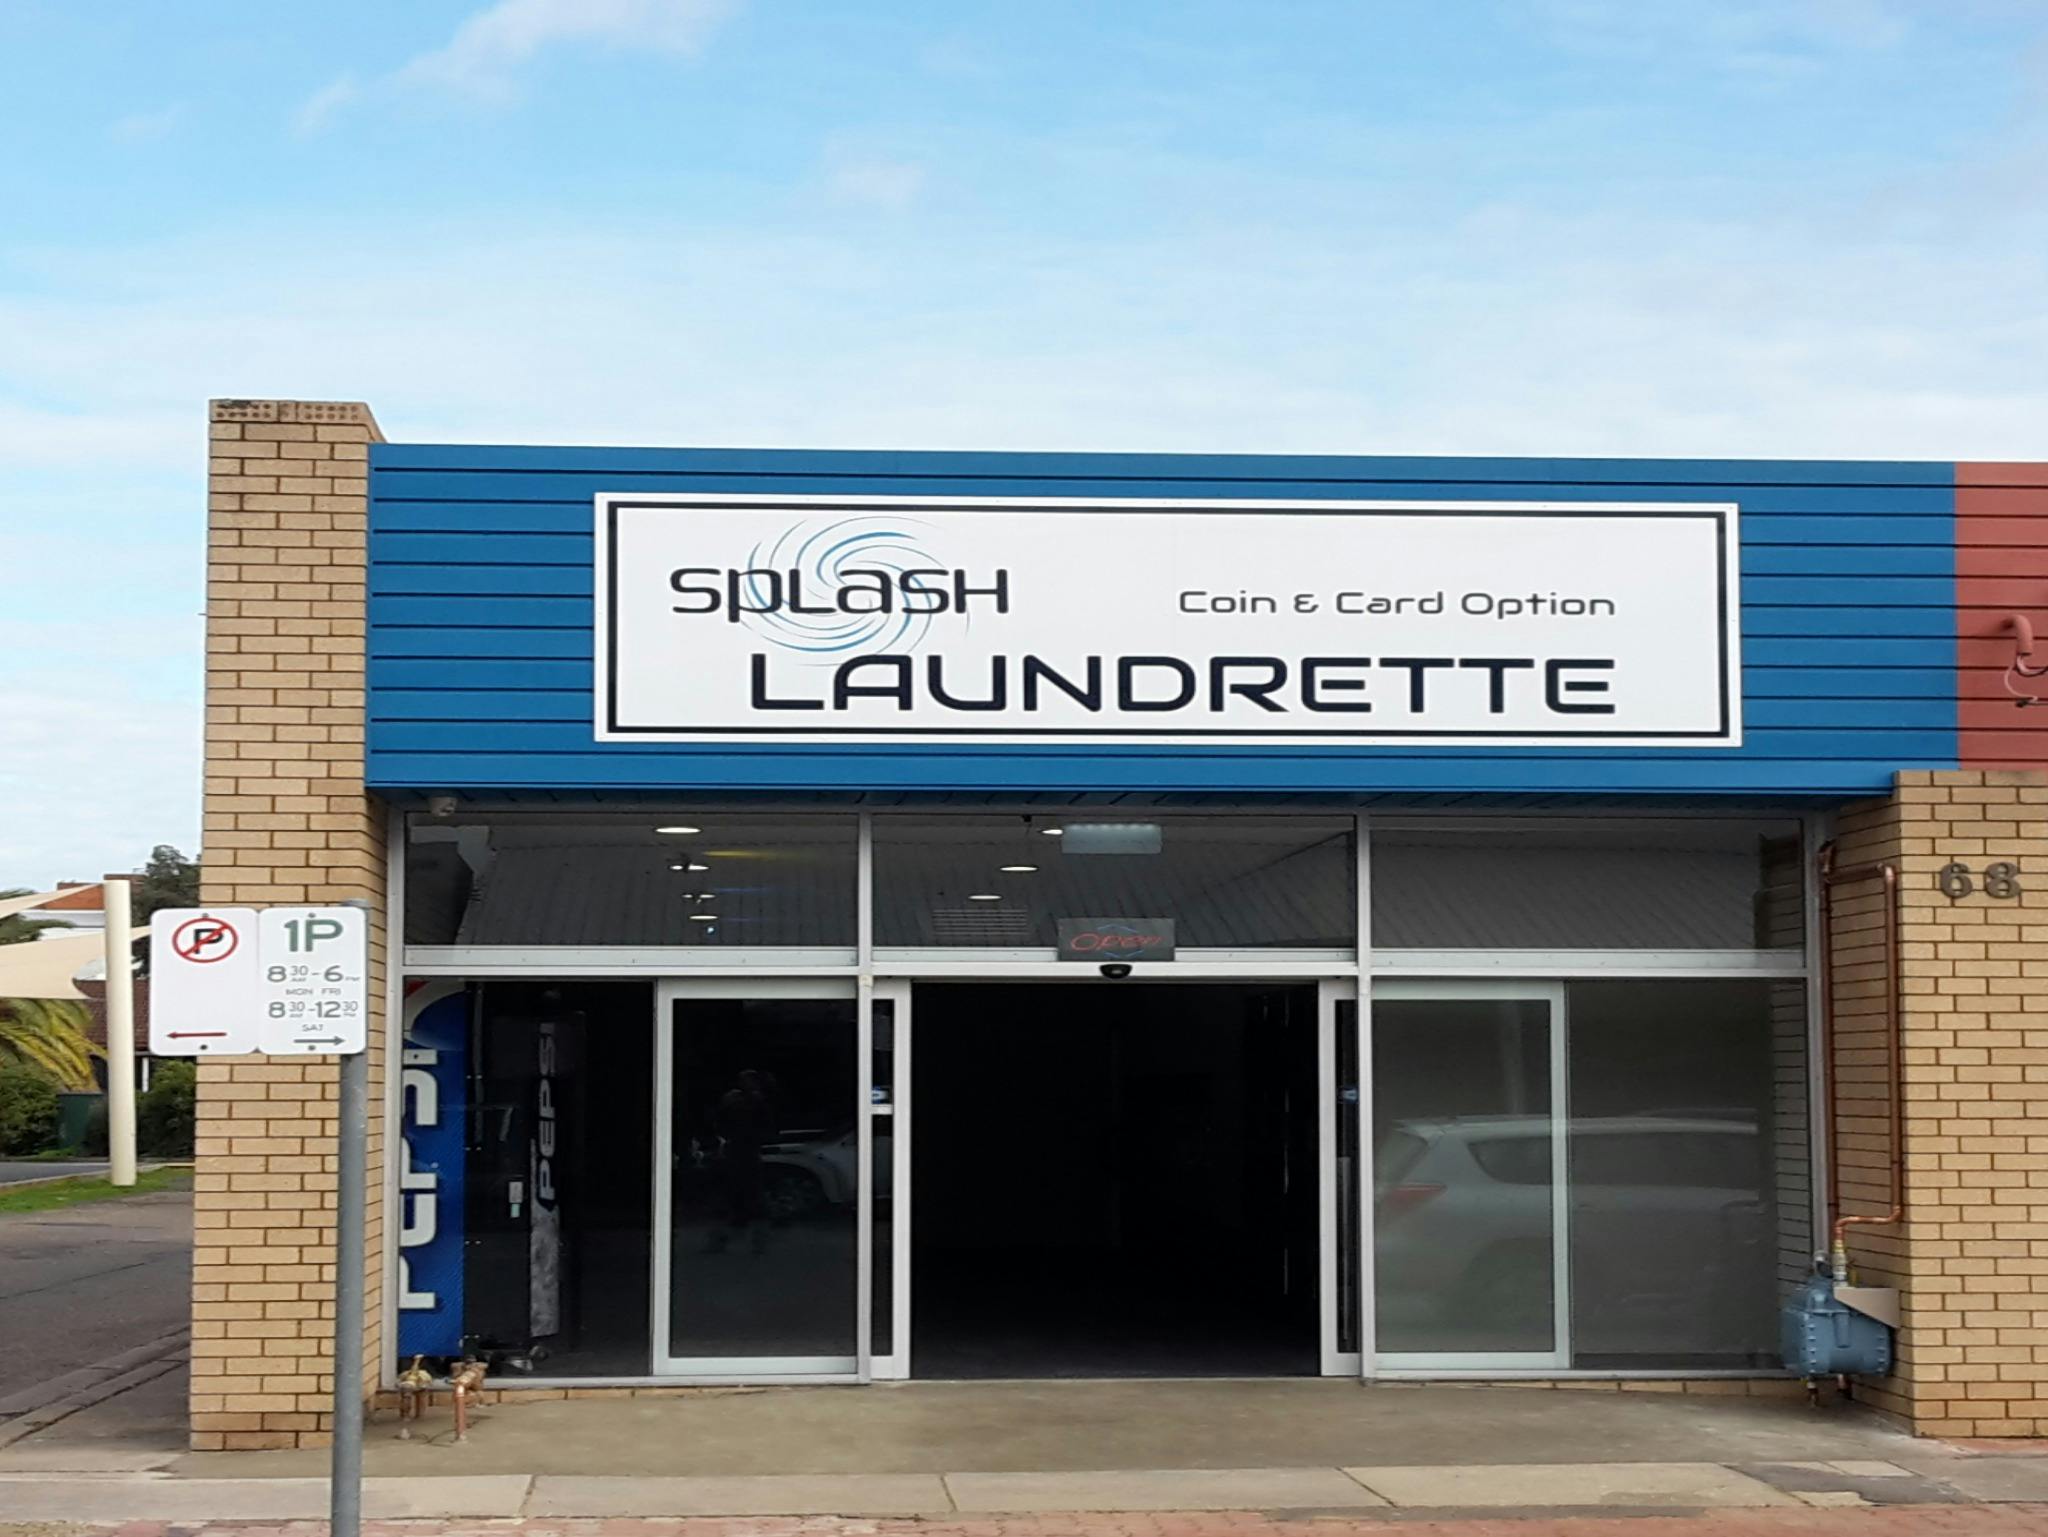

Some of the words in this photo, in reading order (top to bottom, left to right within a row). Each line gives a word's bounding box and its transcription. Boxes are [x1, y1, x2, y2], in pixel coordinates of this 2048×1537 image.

[1179, 590, 1276, 614] Coin
[1293, 593, 1319, 614] &
[1336, 591, 1444, 615] Card
[1461, 592, 1616, 620] Option
[751, 653, 1616, 714] LAUNDRETTE
[1939, 861, 2022, 899] 68
[284, 919, 344, 952] 1P
[538, 1022, 556, 1202] PEPSI
